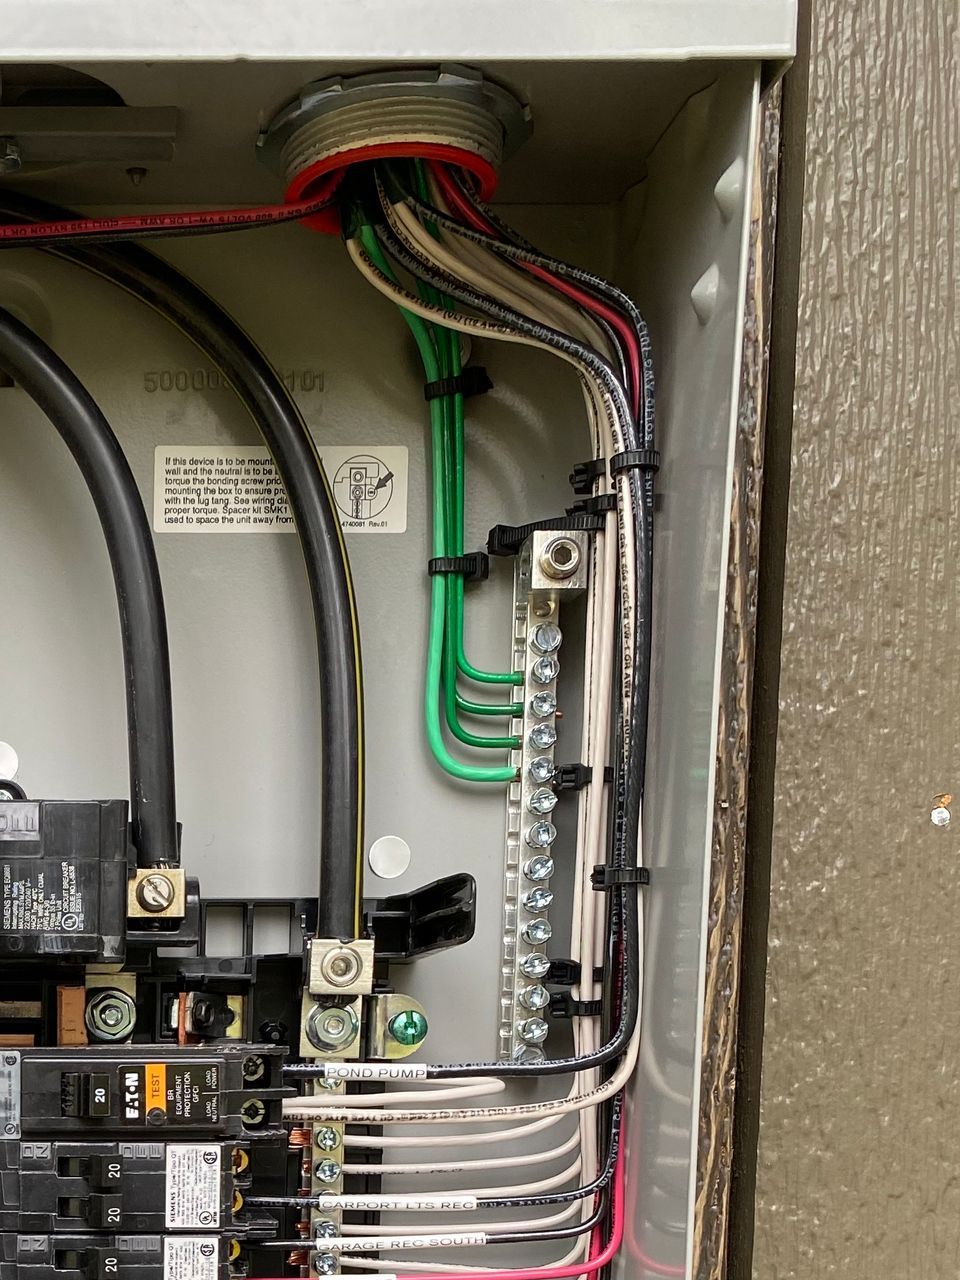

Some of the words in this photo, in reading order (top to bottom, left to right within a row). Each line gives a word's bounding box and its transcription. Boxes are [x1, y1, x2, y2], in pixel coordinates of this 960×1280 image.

[172, 456, 186, 465] this
[189, 456, 214, 465] device
[216, 456, 224, 465] is
[226, 456, 234, 465] to
[236, 456, 246, 465] be
[248, 456, 274, 465] mount
[164, 467, 180, 476] wall
[183, 467, 198, 476] and
[200, 467, 212, 476] the
[214, 467, 242, 476] neutral
[244, 467, 250, 476] is
[252, 467, 260, 476] to
[262, 467, 272, 476] be
[165, 477, 190, 486] torque
[192, 477, 205, 486] the
[207, 477, 238, 486] bonding
[240, 478, 264, 486] screw
[266, 477, 282, 486] prio
[165, 486, 202, 496] mounting
[204, 486, 216, 495] the
[218, 486, 232, 495] box
[234, 486, 242, 495] to
[164, 496, 181, 505] with
[183, 496, 196, 505] the
[198, 496, 210, 506] lug
[212, 496, 231, 506] tang.
[234, 496, 250, 505] See
[252, 496, 274, 506] wiring
[164, 508, 190, 516] proper
[192, 506, 220, 516] torque.
[222, 506, 250, 516] Spacer
[252, 506, 262, 515] kit
[164, 516, 184, 525] used
[186, 516, 194, 525] to
[222, 516, 234, 525] the
[236, 516, 250, 525] unit
[276, 516, 294, 525] from
[327, 1067, 373, 1079] POND
[378, 1067, 426, 1080] PUMP
[152, 1074, 160, 1099] TEST
[95, 1088, 106, 1104] 20
[168, 1090, 174, 1100] BR
[108, 1163, 120, 1179] 20
[322, 1201, 401, 1211] CARPORT
[406, 1202, 436, 1210] LTS
[440, 1201, 474, 1211] REC
[108, 1207, 120, 1222] 20
[318, 1240, 385, 1251] GARAGE
[391, 1239, 424, 1248] REC
[430, 1236, 485, 1246] SOUTH
[106, 1257, 118, 1273] 20
